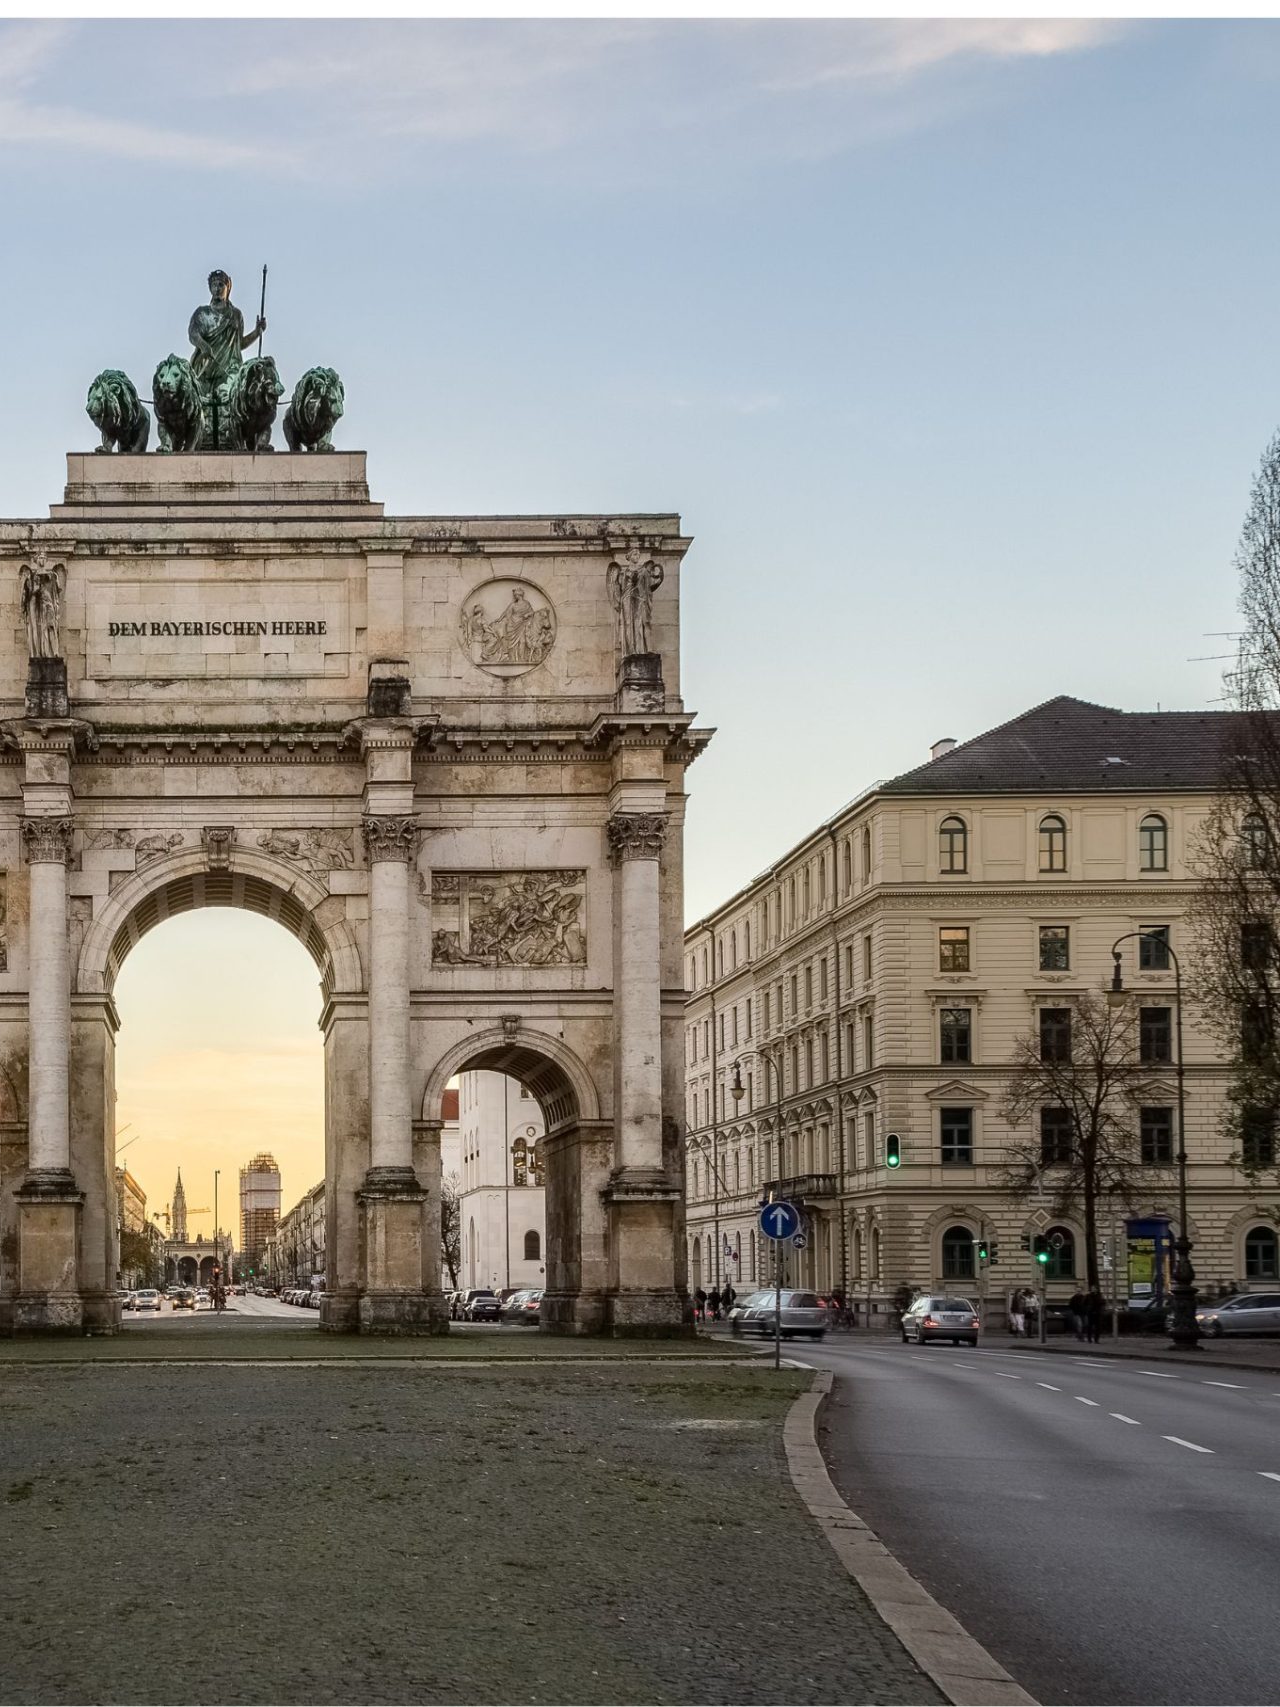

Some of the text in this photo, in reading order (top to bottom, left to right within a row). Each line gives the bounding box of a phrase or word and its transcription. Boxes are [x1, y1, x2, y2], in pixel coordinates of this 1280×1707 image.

[109, 621, 327, 637] DEM BAYERISCHEN HEERE
